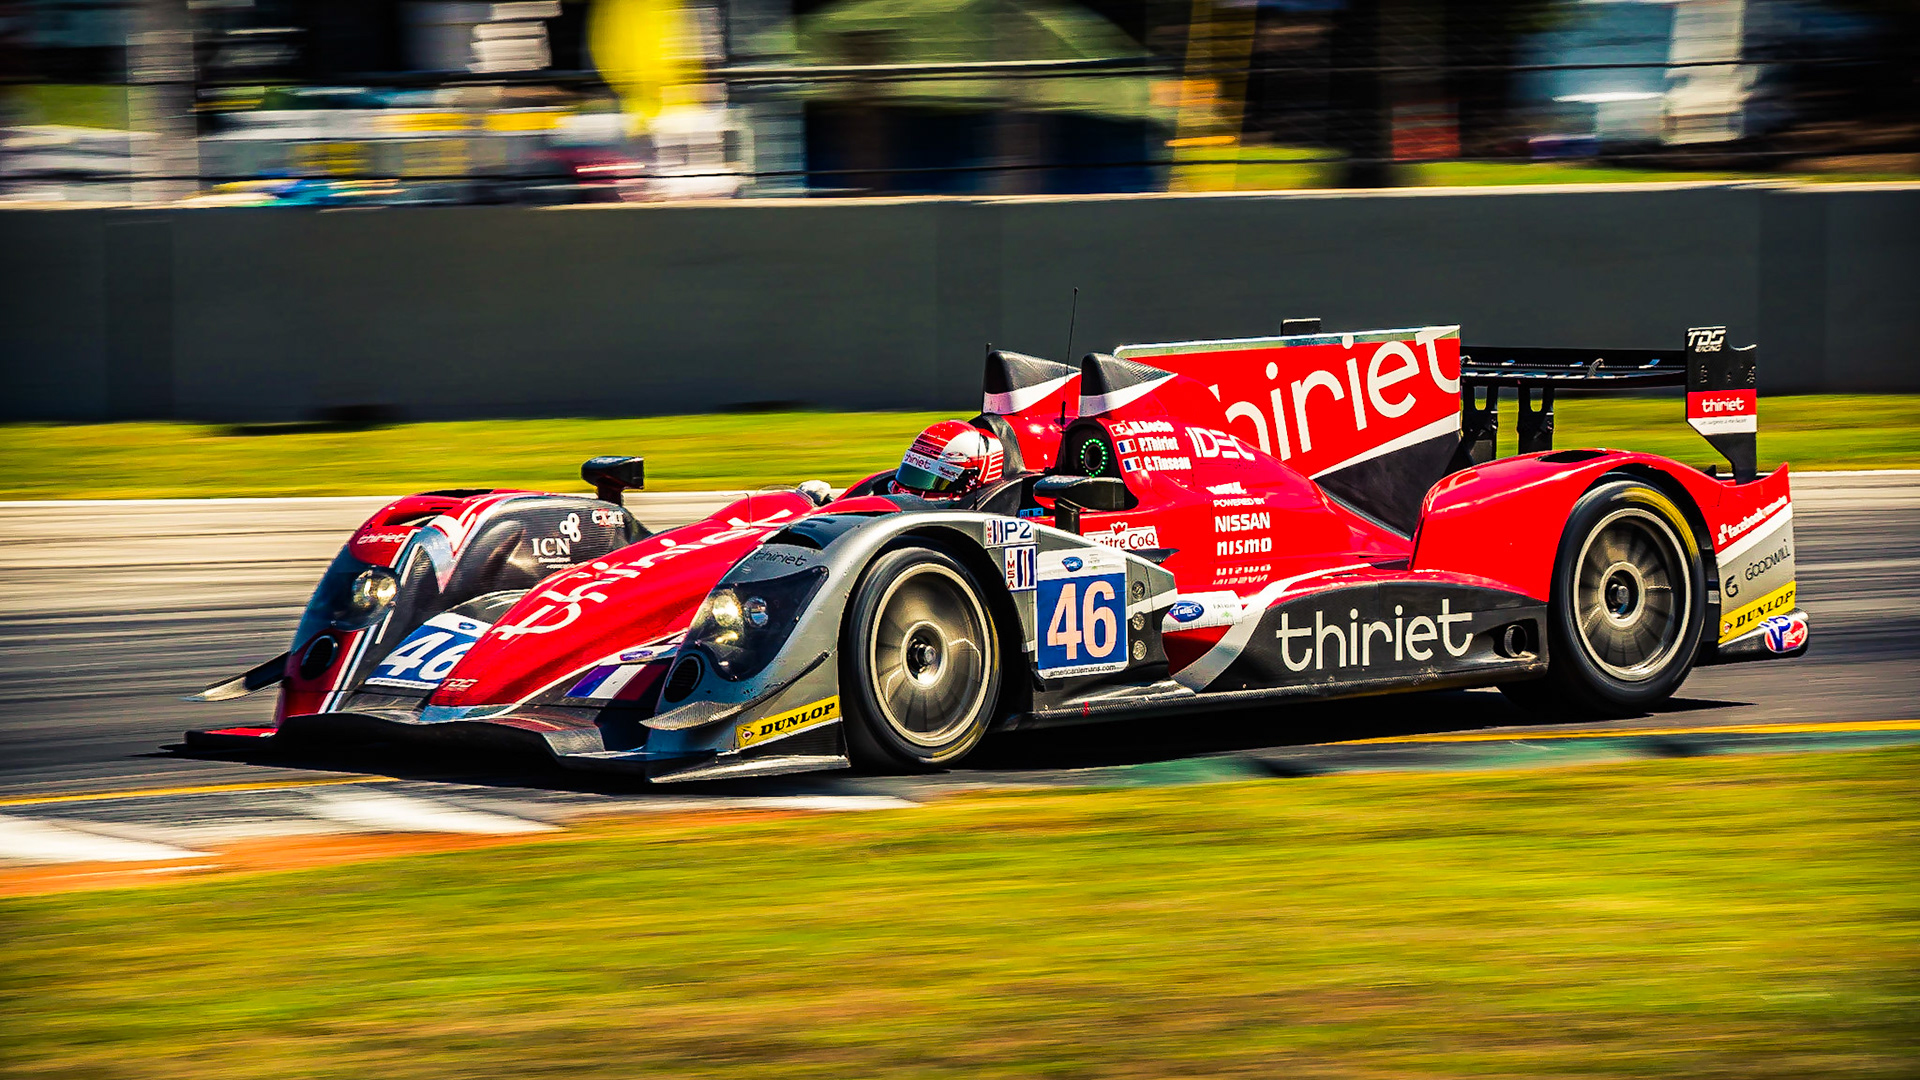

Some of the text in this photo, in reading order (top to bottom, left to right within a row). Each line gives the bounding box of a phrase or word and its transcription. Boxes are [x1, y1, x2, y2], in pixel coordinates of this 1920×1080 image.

[1687, 326, 1727, 347] TDS
[1208, 325, 1460, 462] hiriet
[1702, 397, 1745, 413] thiriet
[1213, 498, 1254, 507] POWERED
[1004, 521, 1032, 540] P2
[1214, 512, 1271, 532] NISSAN
[531, 537, 571, 556] ICN
[1128, 533, 1156, 549] CoQ
[753, 550, 807, 567] thiriet
[1006, 551, 1016, 589] IMSA
[1744, 545, 1791, 582] GOODWILL
[1047, 580, 1118, 661] 46
[1735, 590, 1795, 629] DUNLOP
[1276, 598, 1474, 672] thiriet
[379, 631, 476, 680] 46
[759, 702, 835, 736] DUNLOP
